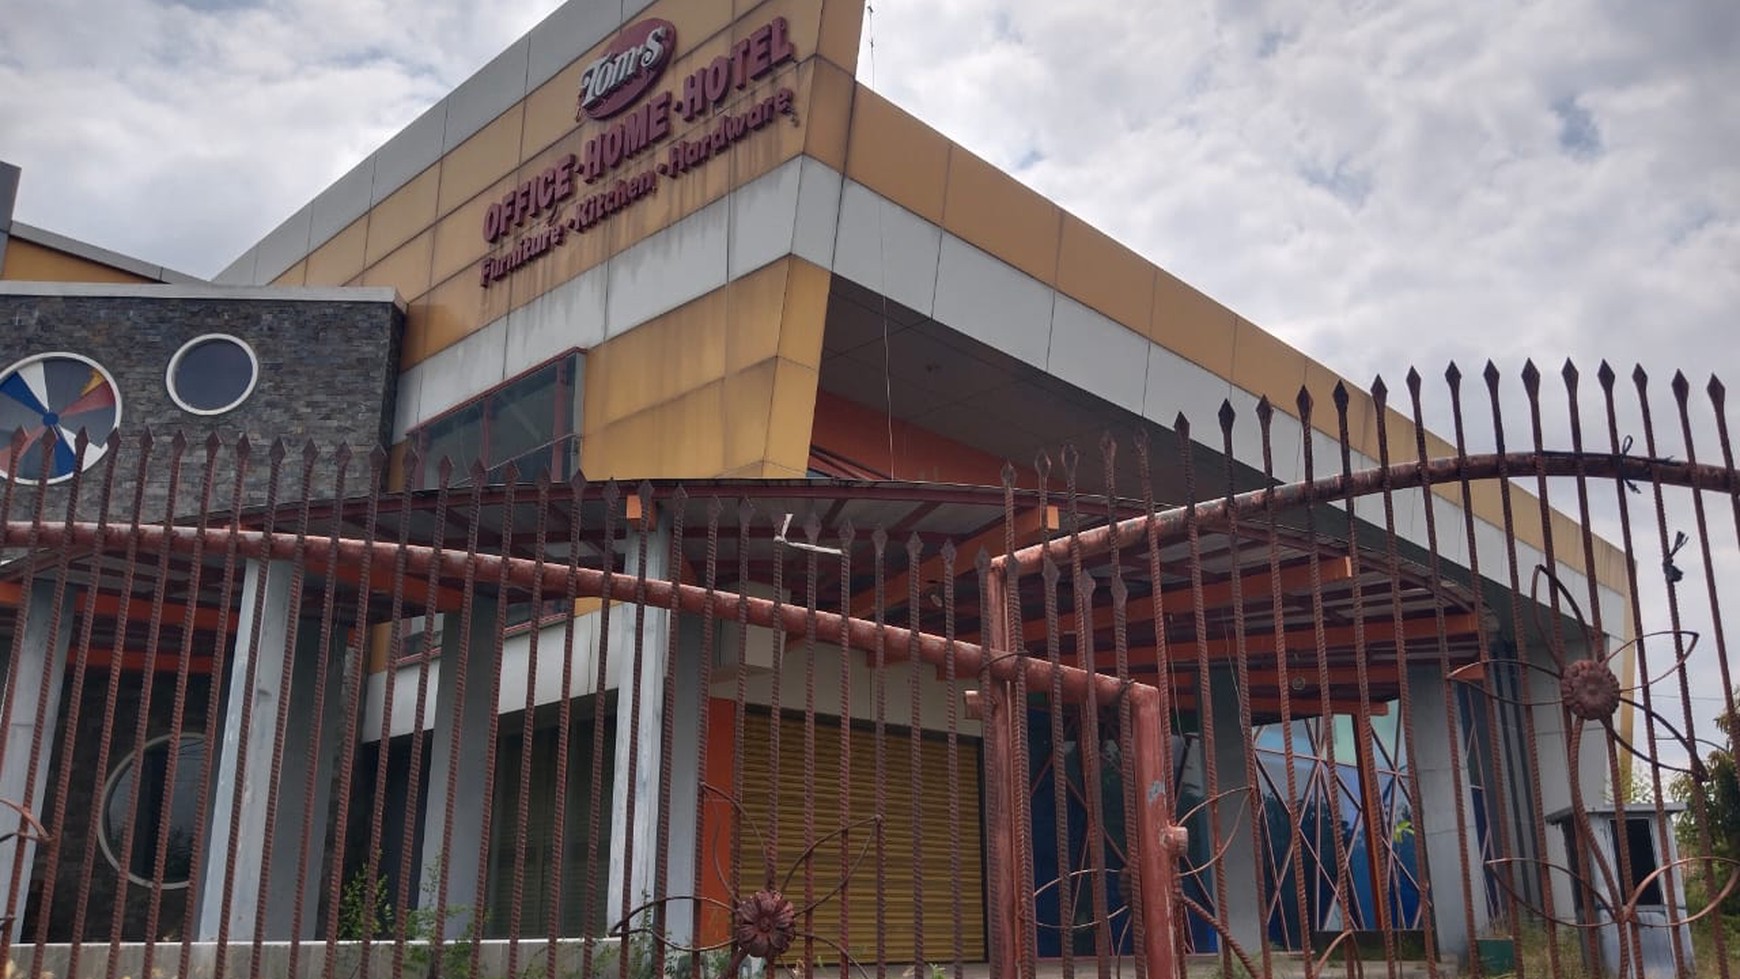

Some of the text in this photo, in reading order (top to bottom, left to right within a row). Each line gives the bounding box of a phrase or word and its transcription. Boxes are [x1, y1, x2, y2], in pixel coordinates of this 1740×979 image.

[480, 88, 793, 288] Furniture Kitchen Hardware
[483, 16, 794, 243] OFFICE HOME HOTEL
